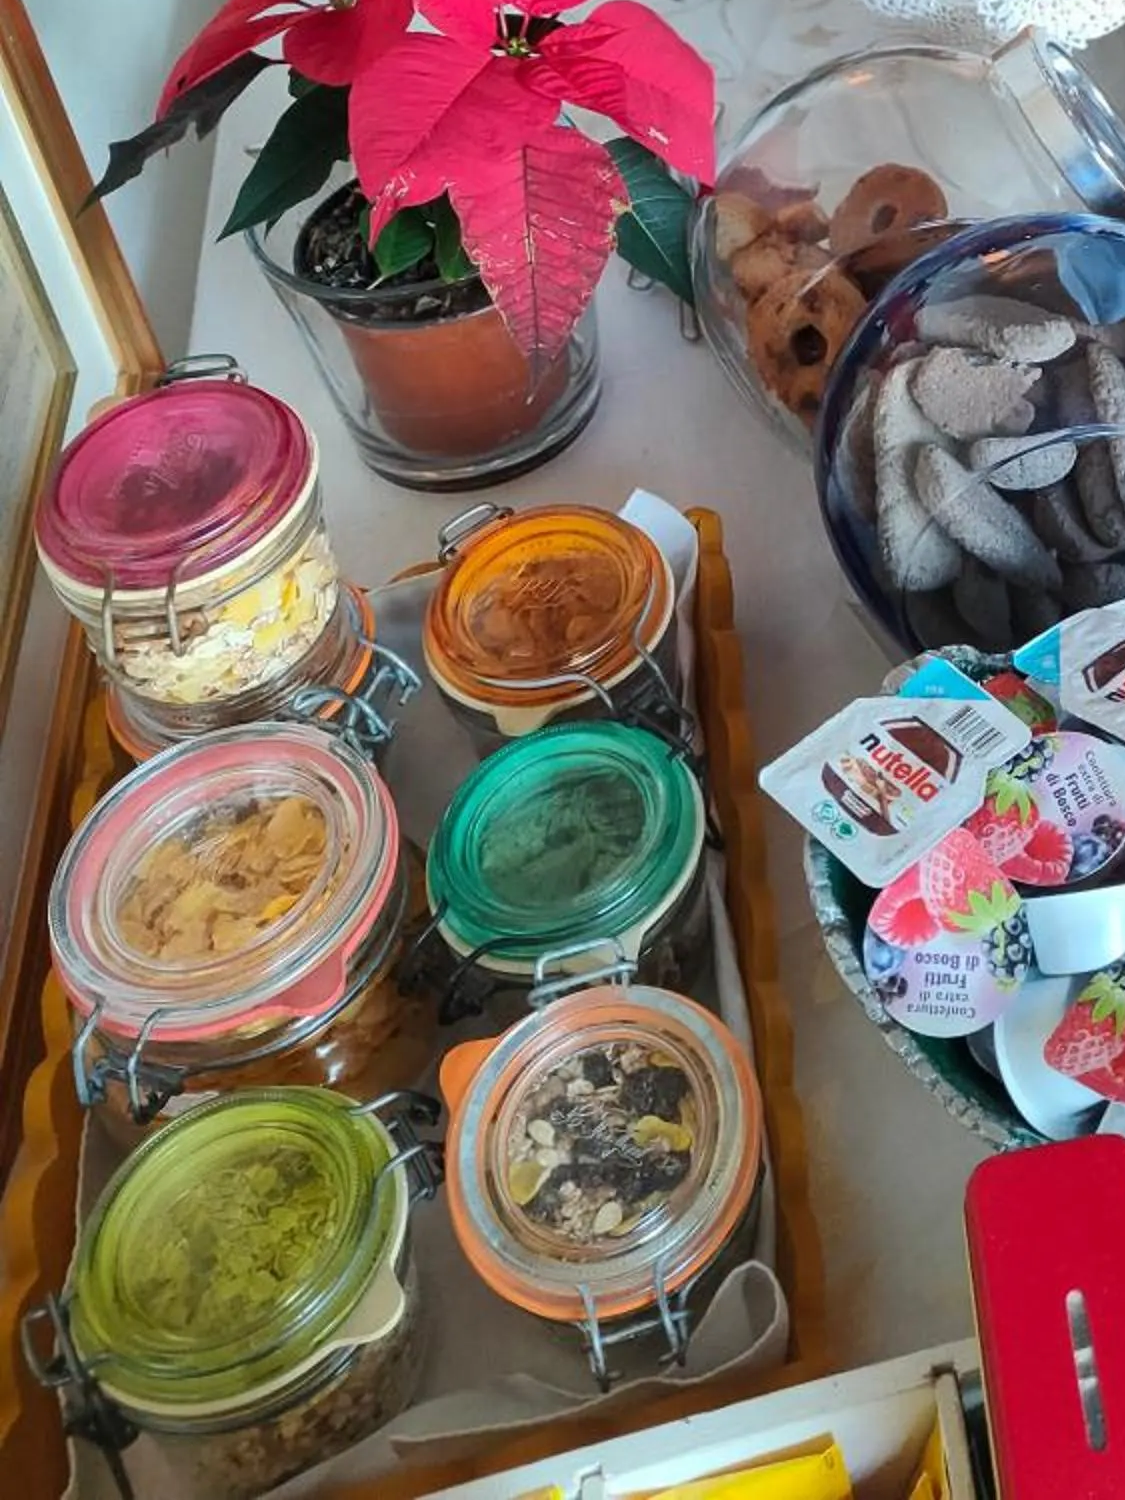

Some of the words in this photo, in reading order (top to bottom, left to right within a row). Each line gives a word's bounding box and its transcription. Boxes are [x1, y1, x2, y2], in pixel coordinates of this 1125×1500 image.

[859, 733, 941, 802] nutella
[1045, 770, 1061, 787] di
[1083, 749, 1118, 807] Confettura
[1064, 772, 1090, 810] Frutti
[1052, 786, 1078, 828] Bosco
[915, 952, 960, 970] Bosco
[965, 955, 979, 971] di
[924, 972, 966, 988] Frutti
[919, 992, 930, 1002] di
[936, 992, 968, 1002] extra
[907, 1004, 976, 1019] Confettura
